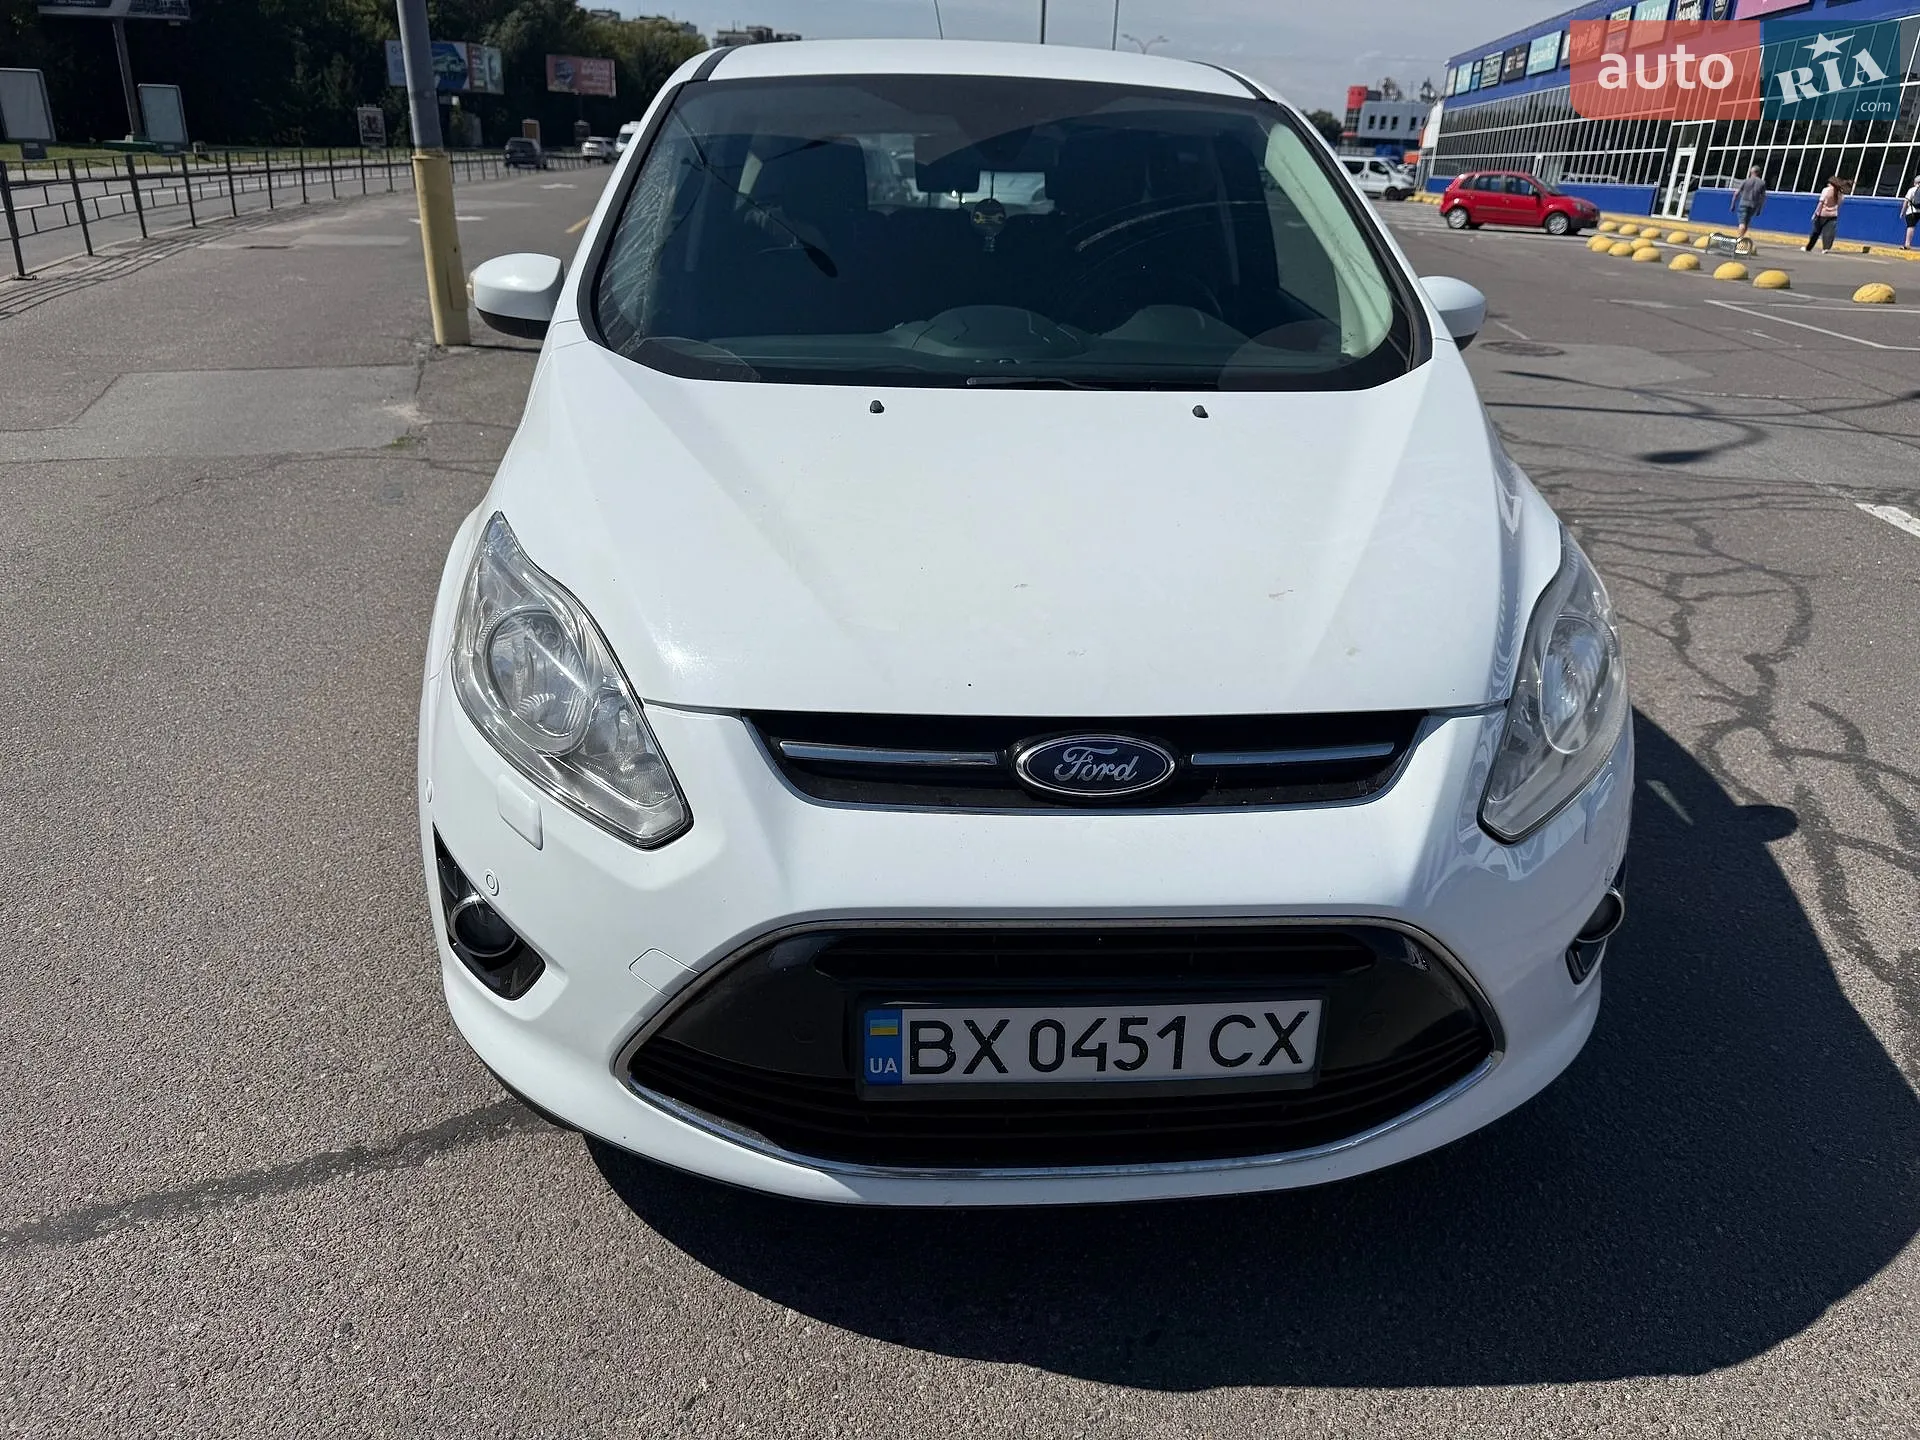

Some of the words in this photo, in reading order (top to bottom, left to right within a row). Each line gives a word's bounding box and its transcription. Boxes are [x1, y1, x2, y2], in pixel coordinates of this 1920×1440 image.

[1054, 746, 1139, 781] Ford
[909, 1019, 1009, 1075] BX
[1028, 1015, 1186, 1073] 0451
[1209, 1011, 1309, 1068] CX
[869, 1058, 898, 1074] UA
